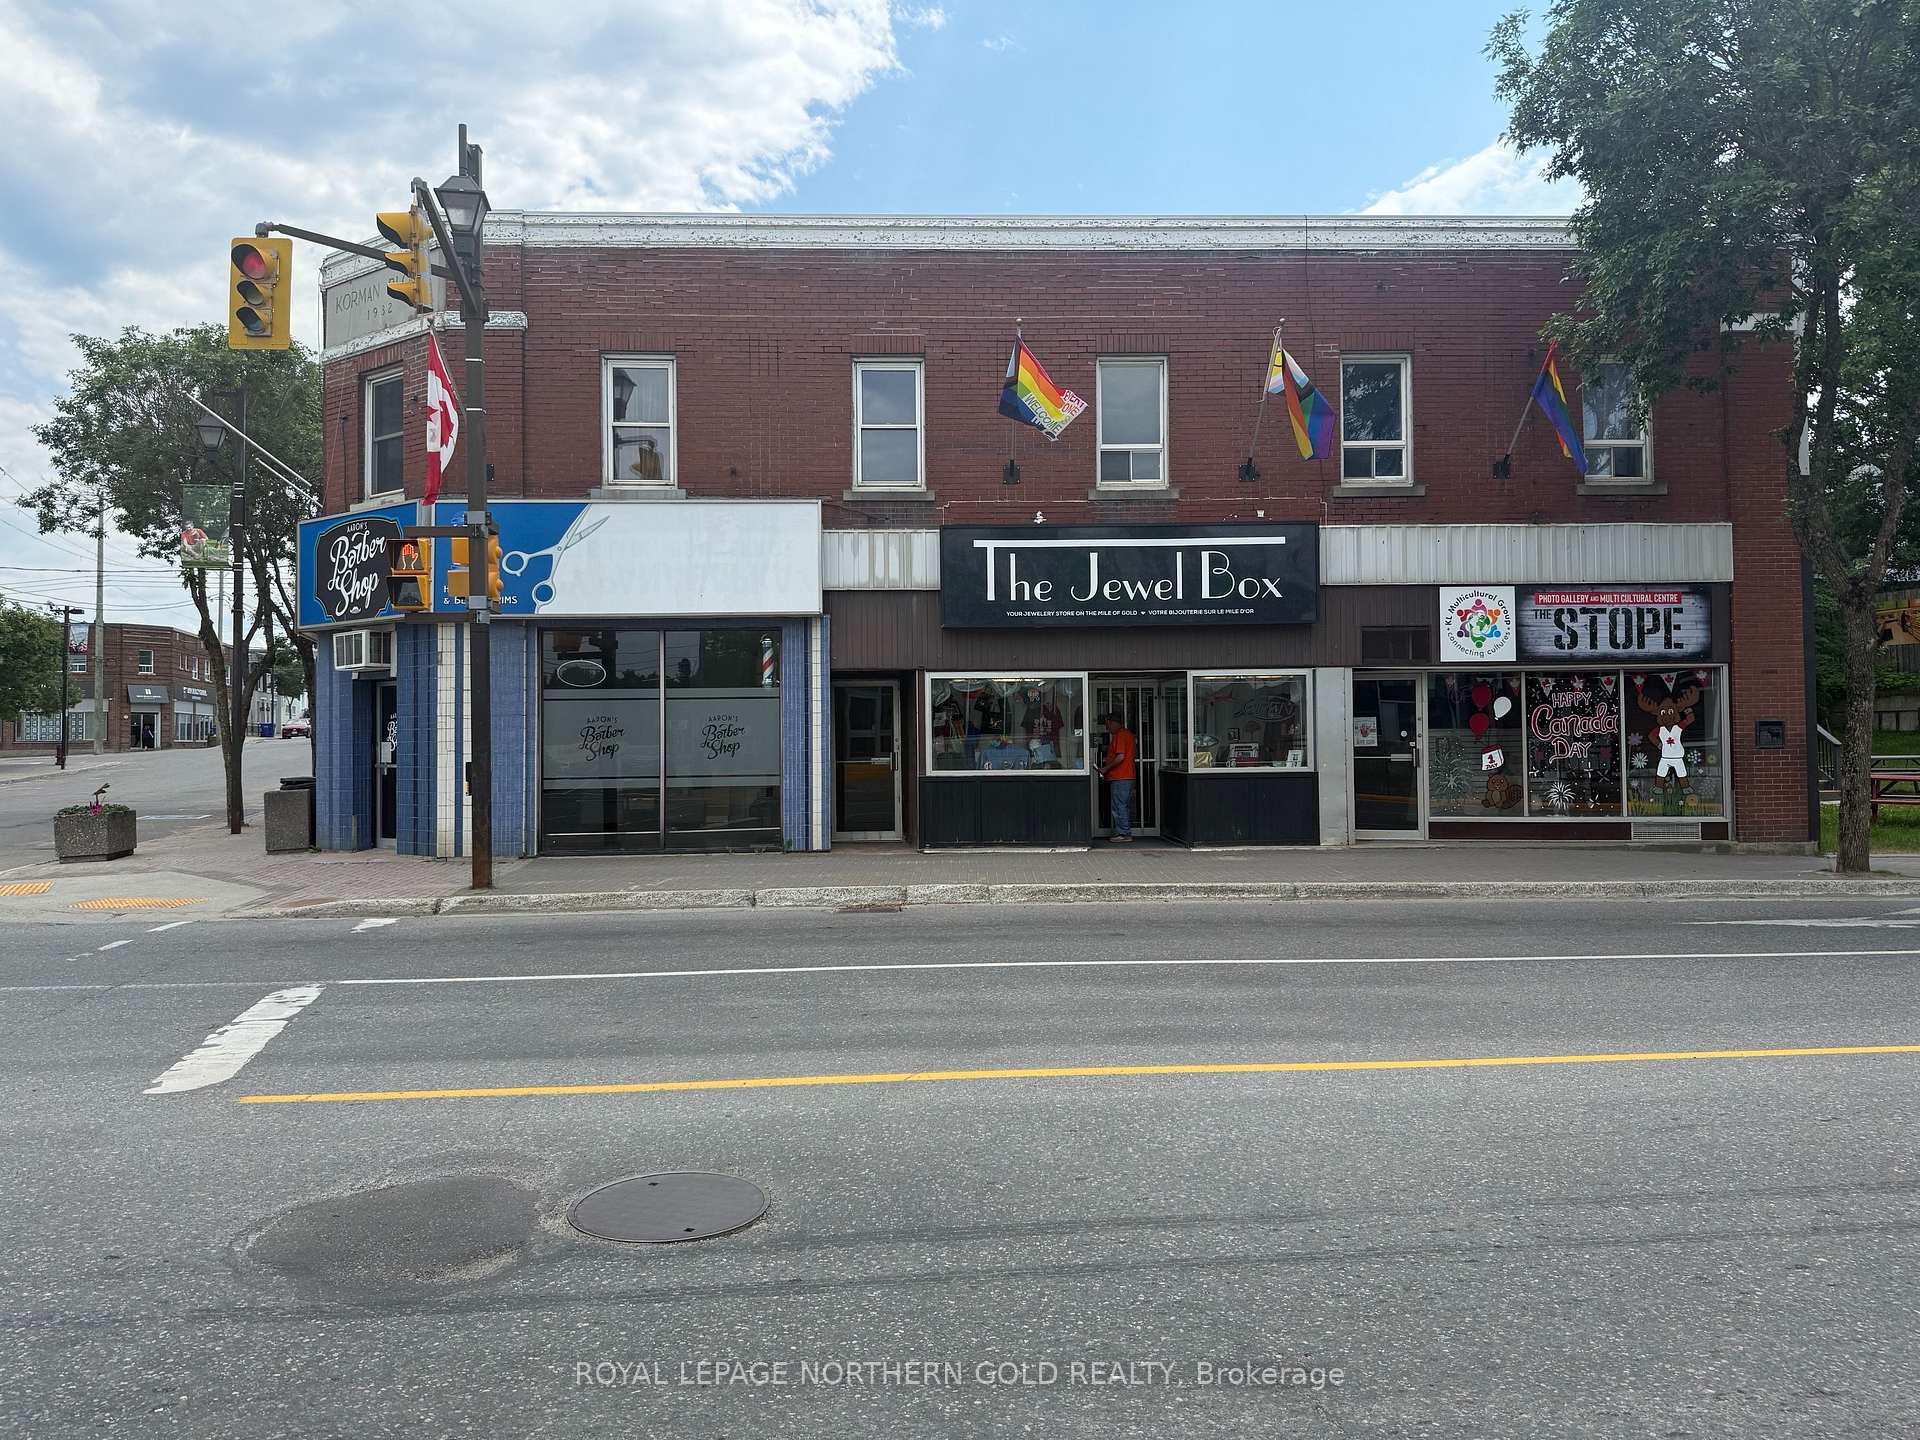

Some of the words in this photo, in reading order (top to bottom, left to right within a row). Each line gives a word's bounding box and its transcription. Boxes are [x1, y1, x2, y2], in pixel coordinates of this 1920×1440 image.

[336, 283, 380, 314] KORMAN
[367, 302, 393, 320] 1932
[1026, 393, 1063, 435] WELCOME
[327, 530, 387, 591] Barber
[1070, 551, 1183, 602] Jewel
[1201, 551, 1284, 600] Box
[335, 568, 380, 616] Shop
[1447, 590, 1498, 614] Multicultural
[1538, 594, 1561, 603] PHOTO
[1560, 594, 1589, 603] GALLERY
[1599, 593, 1620, 603] MULTI
[1620, 593, 1653, 603] CULTURAL
[1653, 593, 1678, 603] CENTRE
[1445, 615, 1453, 626] KL
[1497, 599, 1511, 625] Group
[1533, 608, 1552, 620] THE
[1553, 606, 1684, 650] STOPE
[1447, 632, 1485, 659] connecting
[1486, 631, 1511, 655] cultures
[1552, 691, 1592, 708] HAPPY
[1531, 702, 1619, 741] Canada
[579, 725, 625, 750] Barber
[700, 724, 745, 749] Barber
[585, 741, 620, 761] Shop
[707, 739, 740, 760] Shop
[1487, 754, 1496, 765] 1
[1549, 736, 1592, 764] DAY
